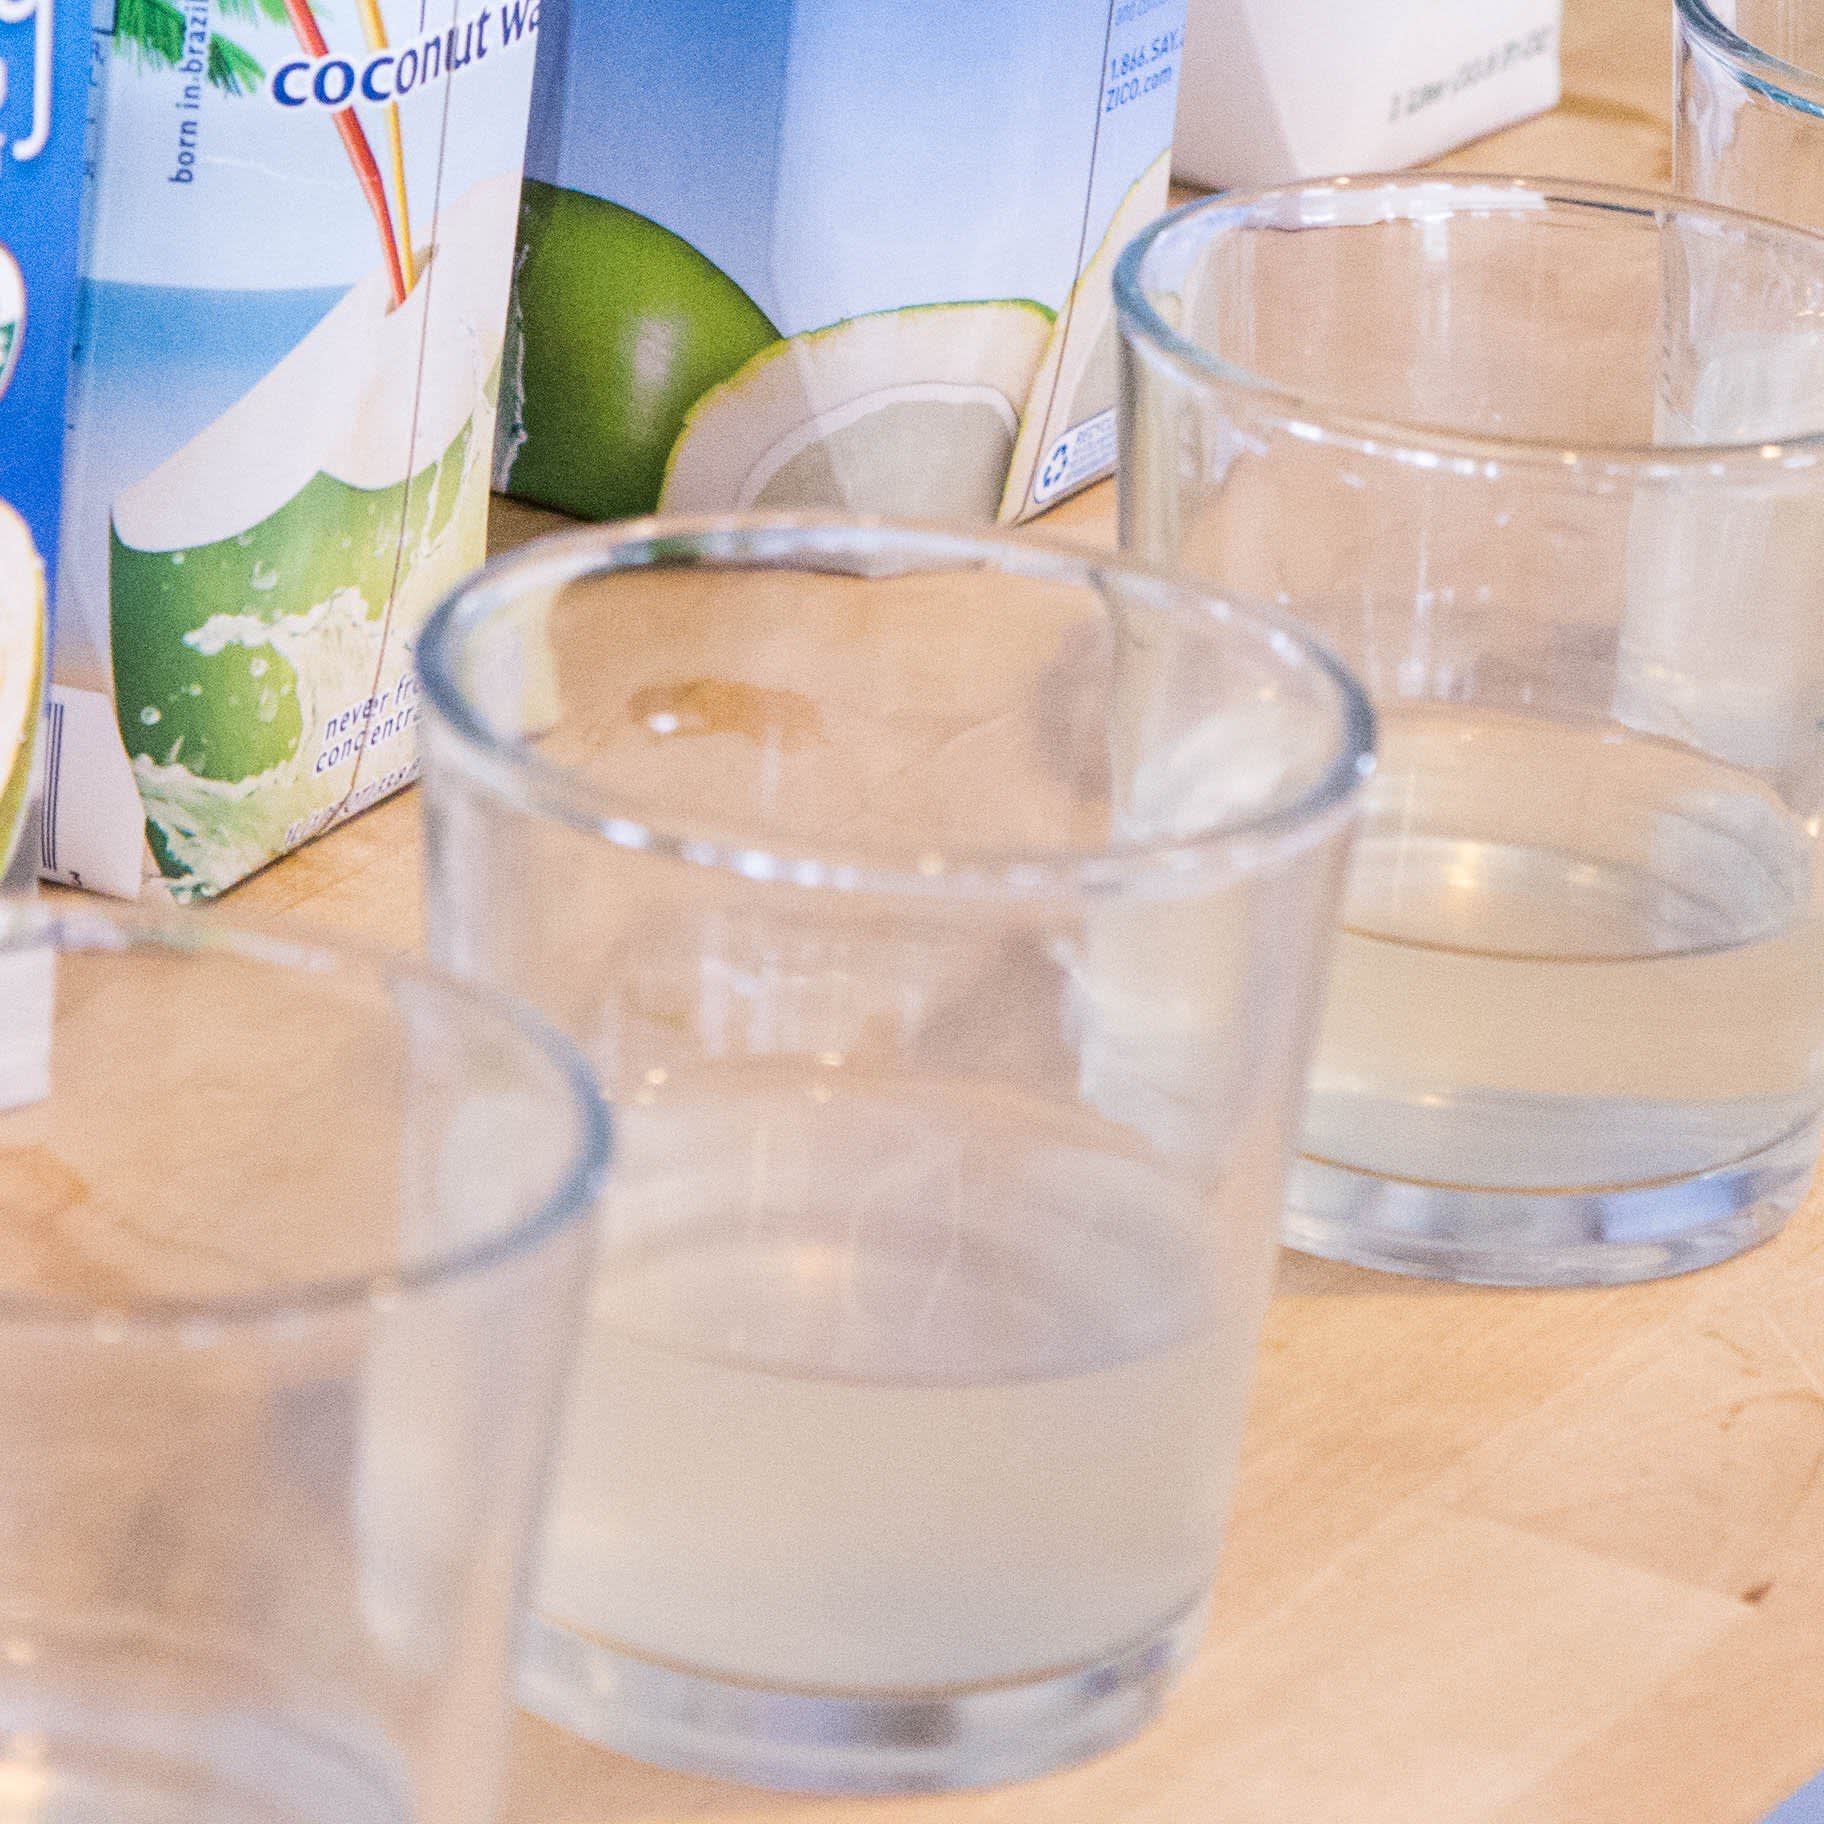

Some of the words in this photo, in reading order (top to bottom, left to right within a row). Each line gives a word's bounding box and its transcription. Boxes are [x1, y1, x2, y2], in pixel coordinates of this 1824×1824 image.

[271, 3, 492, 110] coconut
[168, 119, 194, 183] born
[181, 76, 200, 109] in
[325, 691, 389, 739] never
